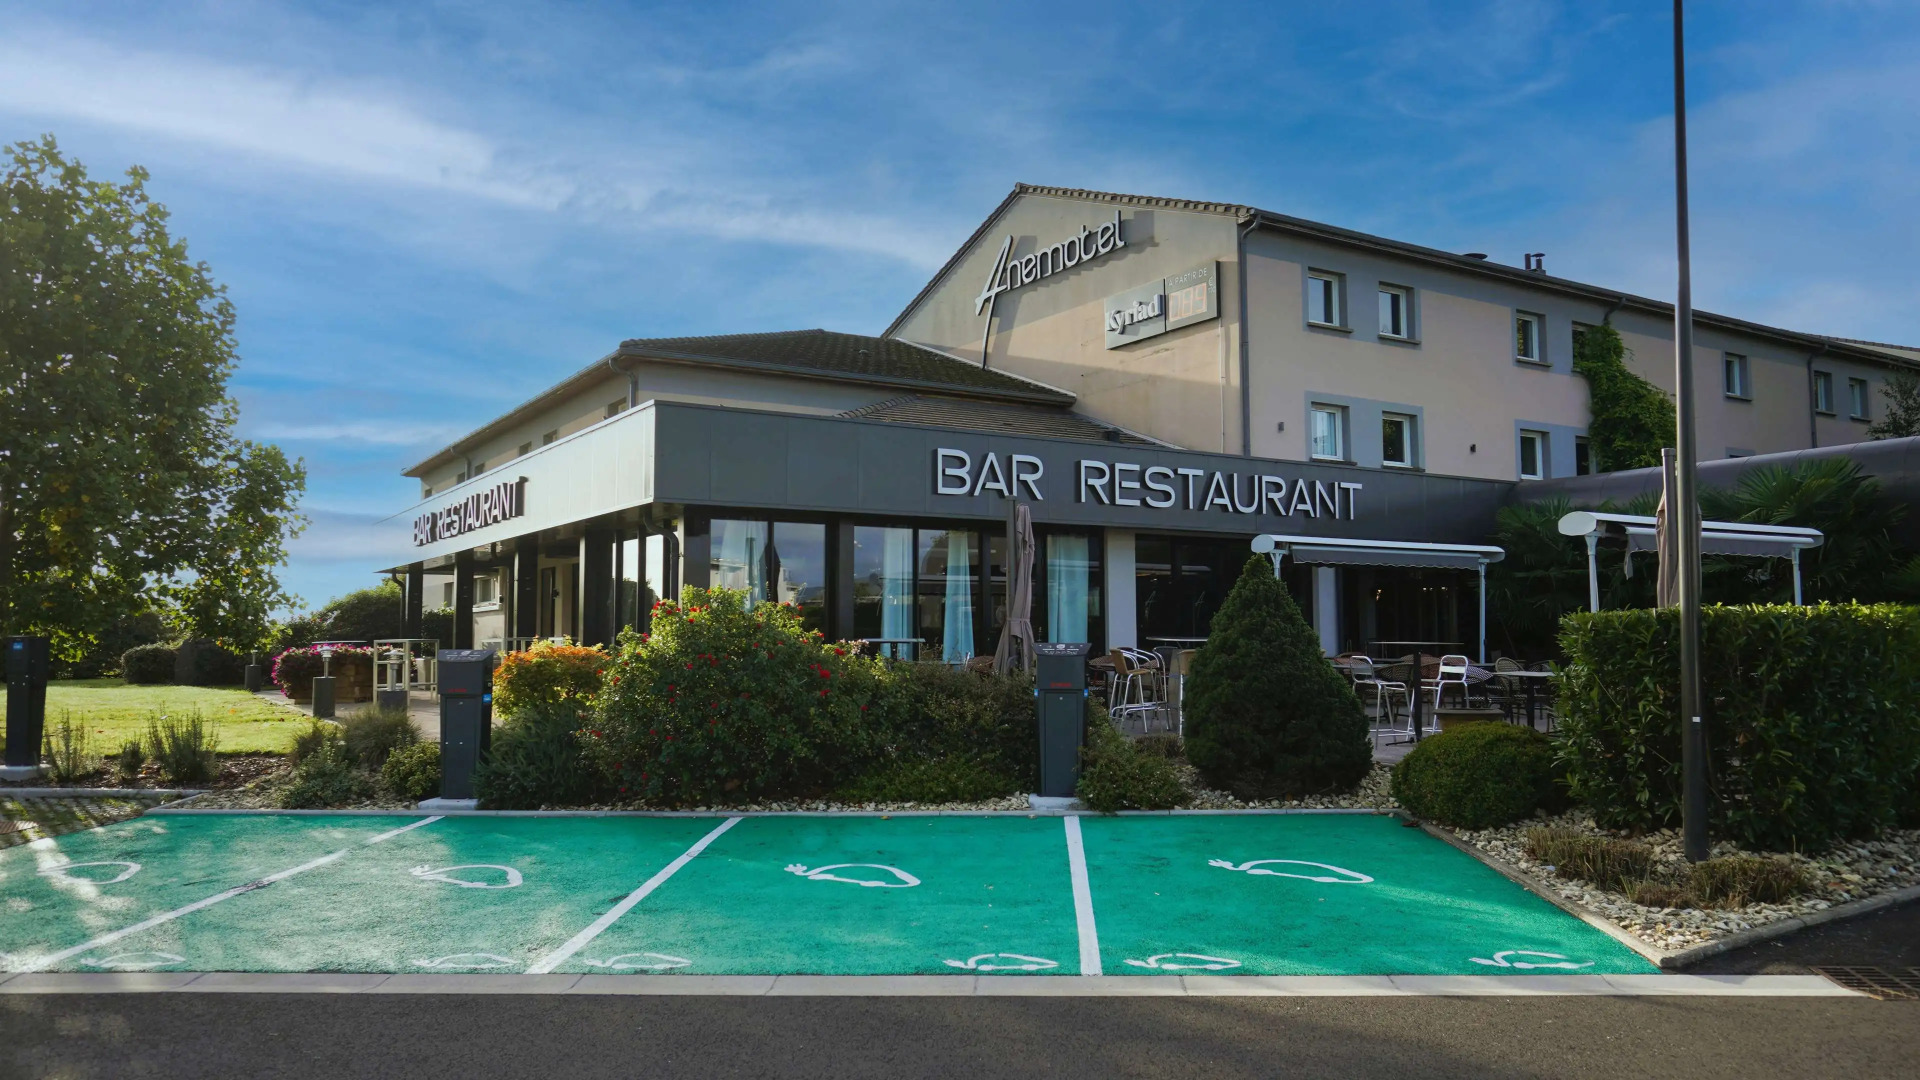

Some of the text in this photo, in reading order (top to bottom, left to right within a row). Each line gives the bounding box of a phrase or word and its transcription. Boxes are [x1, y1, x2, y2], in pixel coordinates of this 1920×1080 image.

[975, 210, 1125, 369] Anemotel
[1174, 271, 1197, 285] PARTIR
[1198, 267, 1207, 278] DE
[1105, 294, 1161, 334] Kyriad
[414, 481, 516, 543] BAR RESTAURANT
[937, 447, 1363, 520] BAR RESTAURANT
